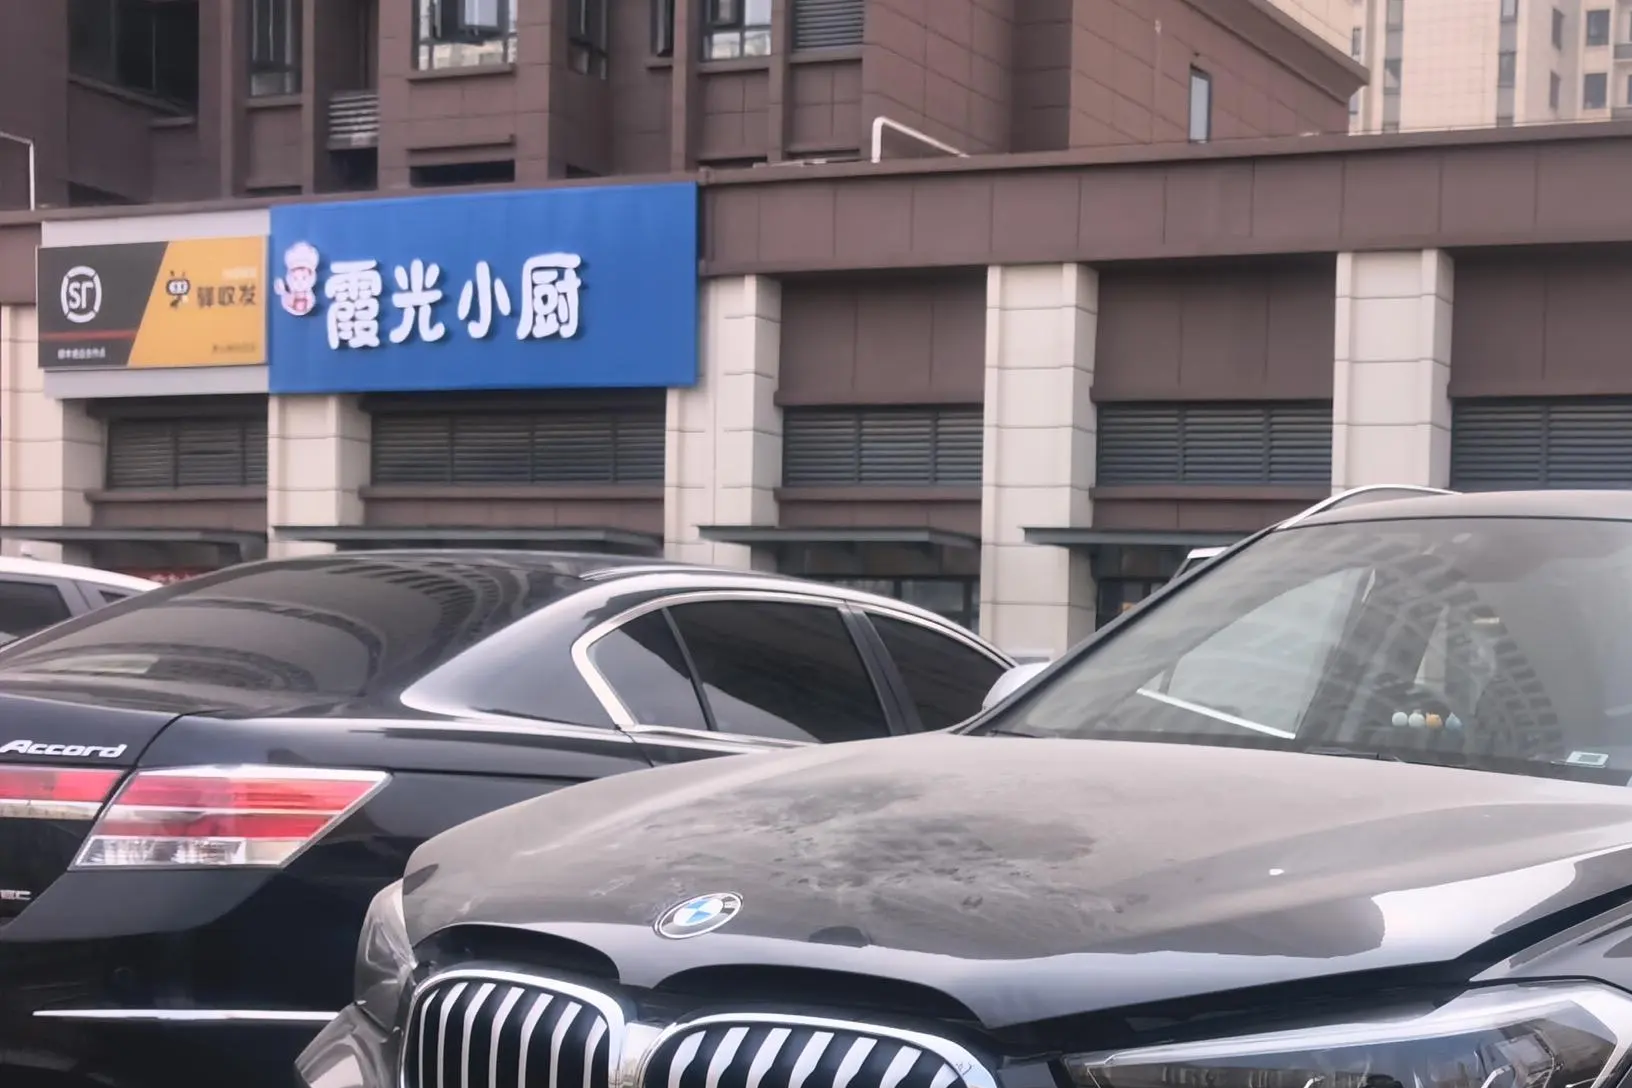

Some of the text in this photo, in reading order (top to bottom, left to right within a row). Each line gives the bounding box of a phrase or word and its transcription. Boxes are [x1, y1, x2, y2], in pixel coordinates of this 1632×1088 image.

[325, 252, 581, 350] 霞光小厨
[0, 739, 127, 759] Accord
